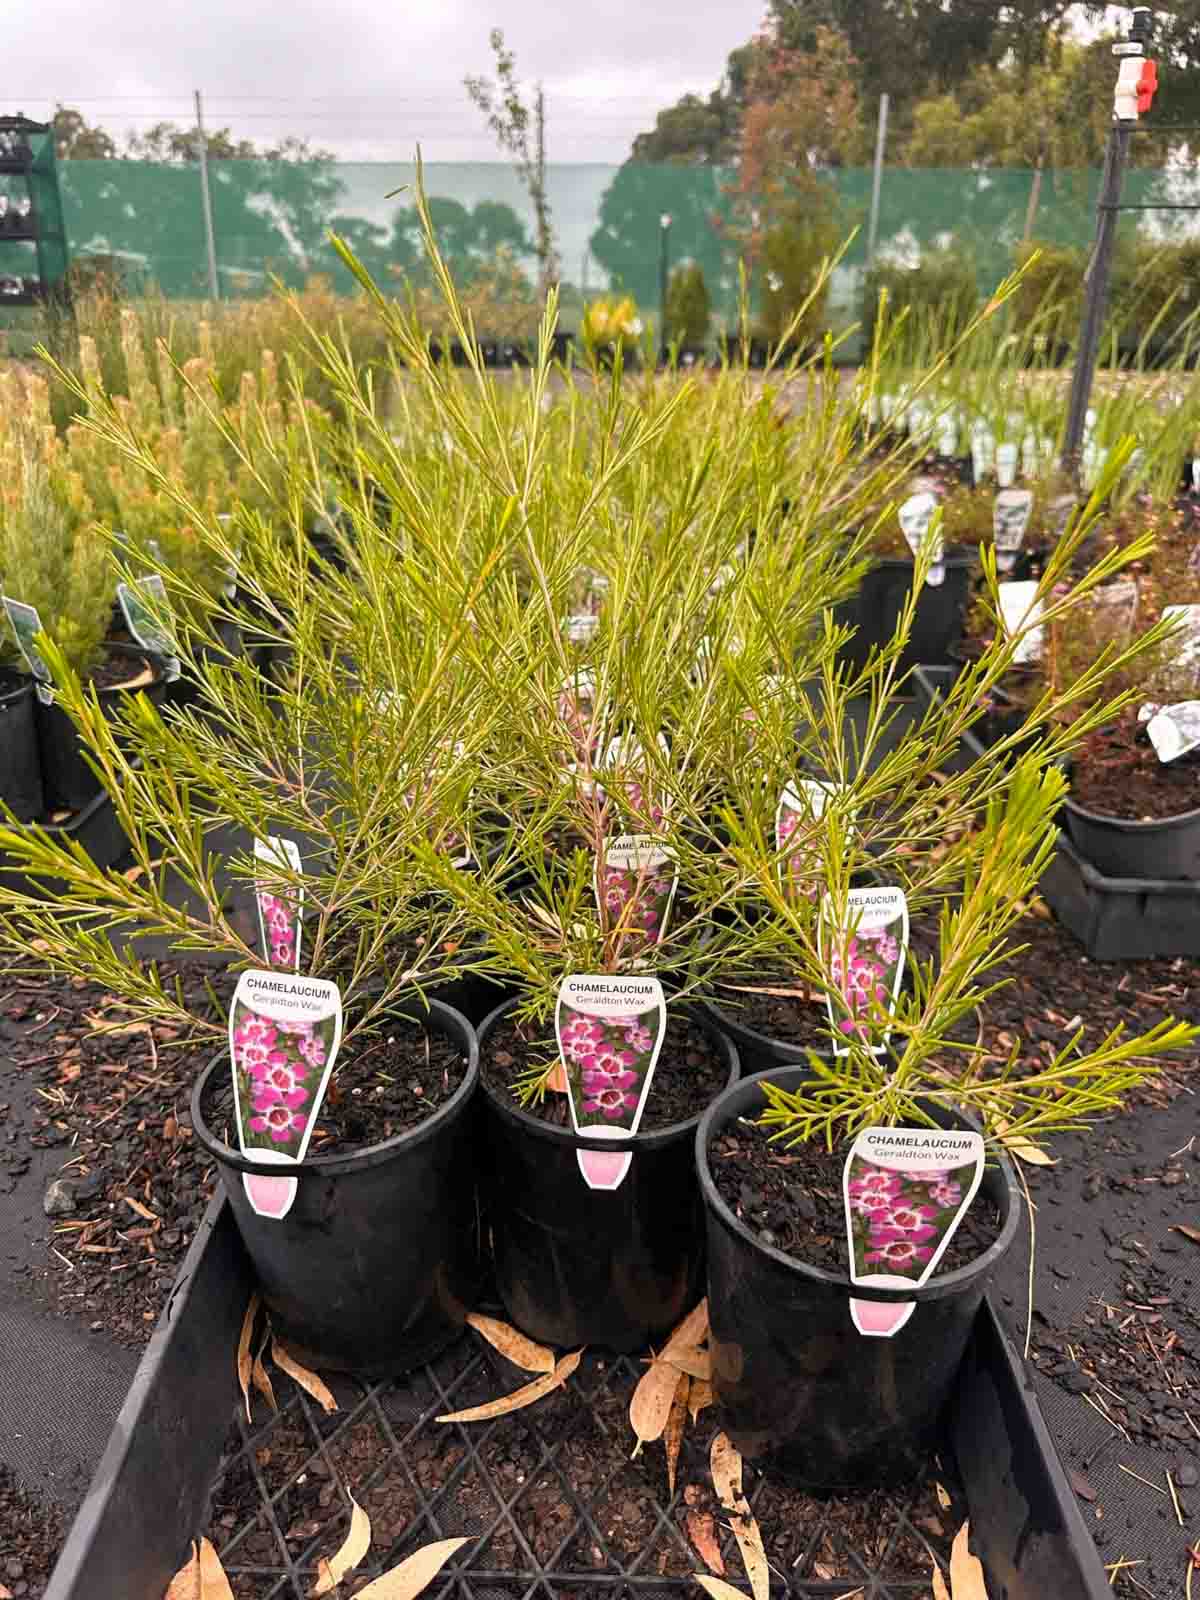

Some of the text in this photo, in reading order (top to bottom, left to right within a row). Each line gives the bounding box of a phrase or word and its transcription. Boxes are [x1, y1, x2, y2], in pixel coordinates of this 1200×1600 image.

[846, 895, 897, 906] MELAUCIUM
[246, 978, 331, 1000] CHAMELAUCIUM
[569, 983, 653, 994] CHAMELAUCIUM
[624, 997, 646, 1006] Wax
[867, 1135, 973, 1149] CHAMELAUCIUM
[874, 1146, 961, 1161] Geraldton Wax
